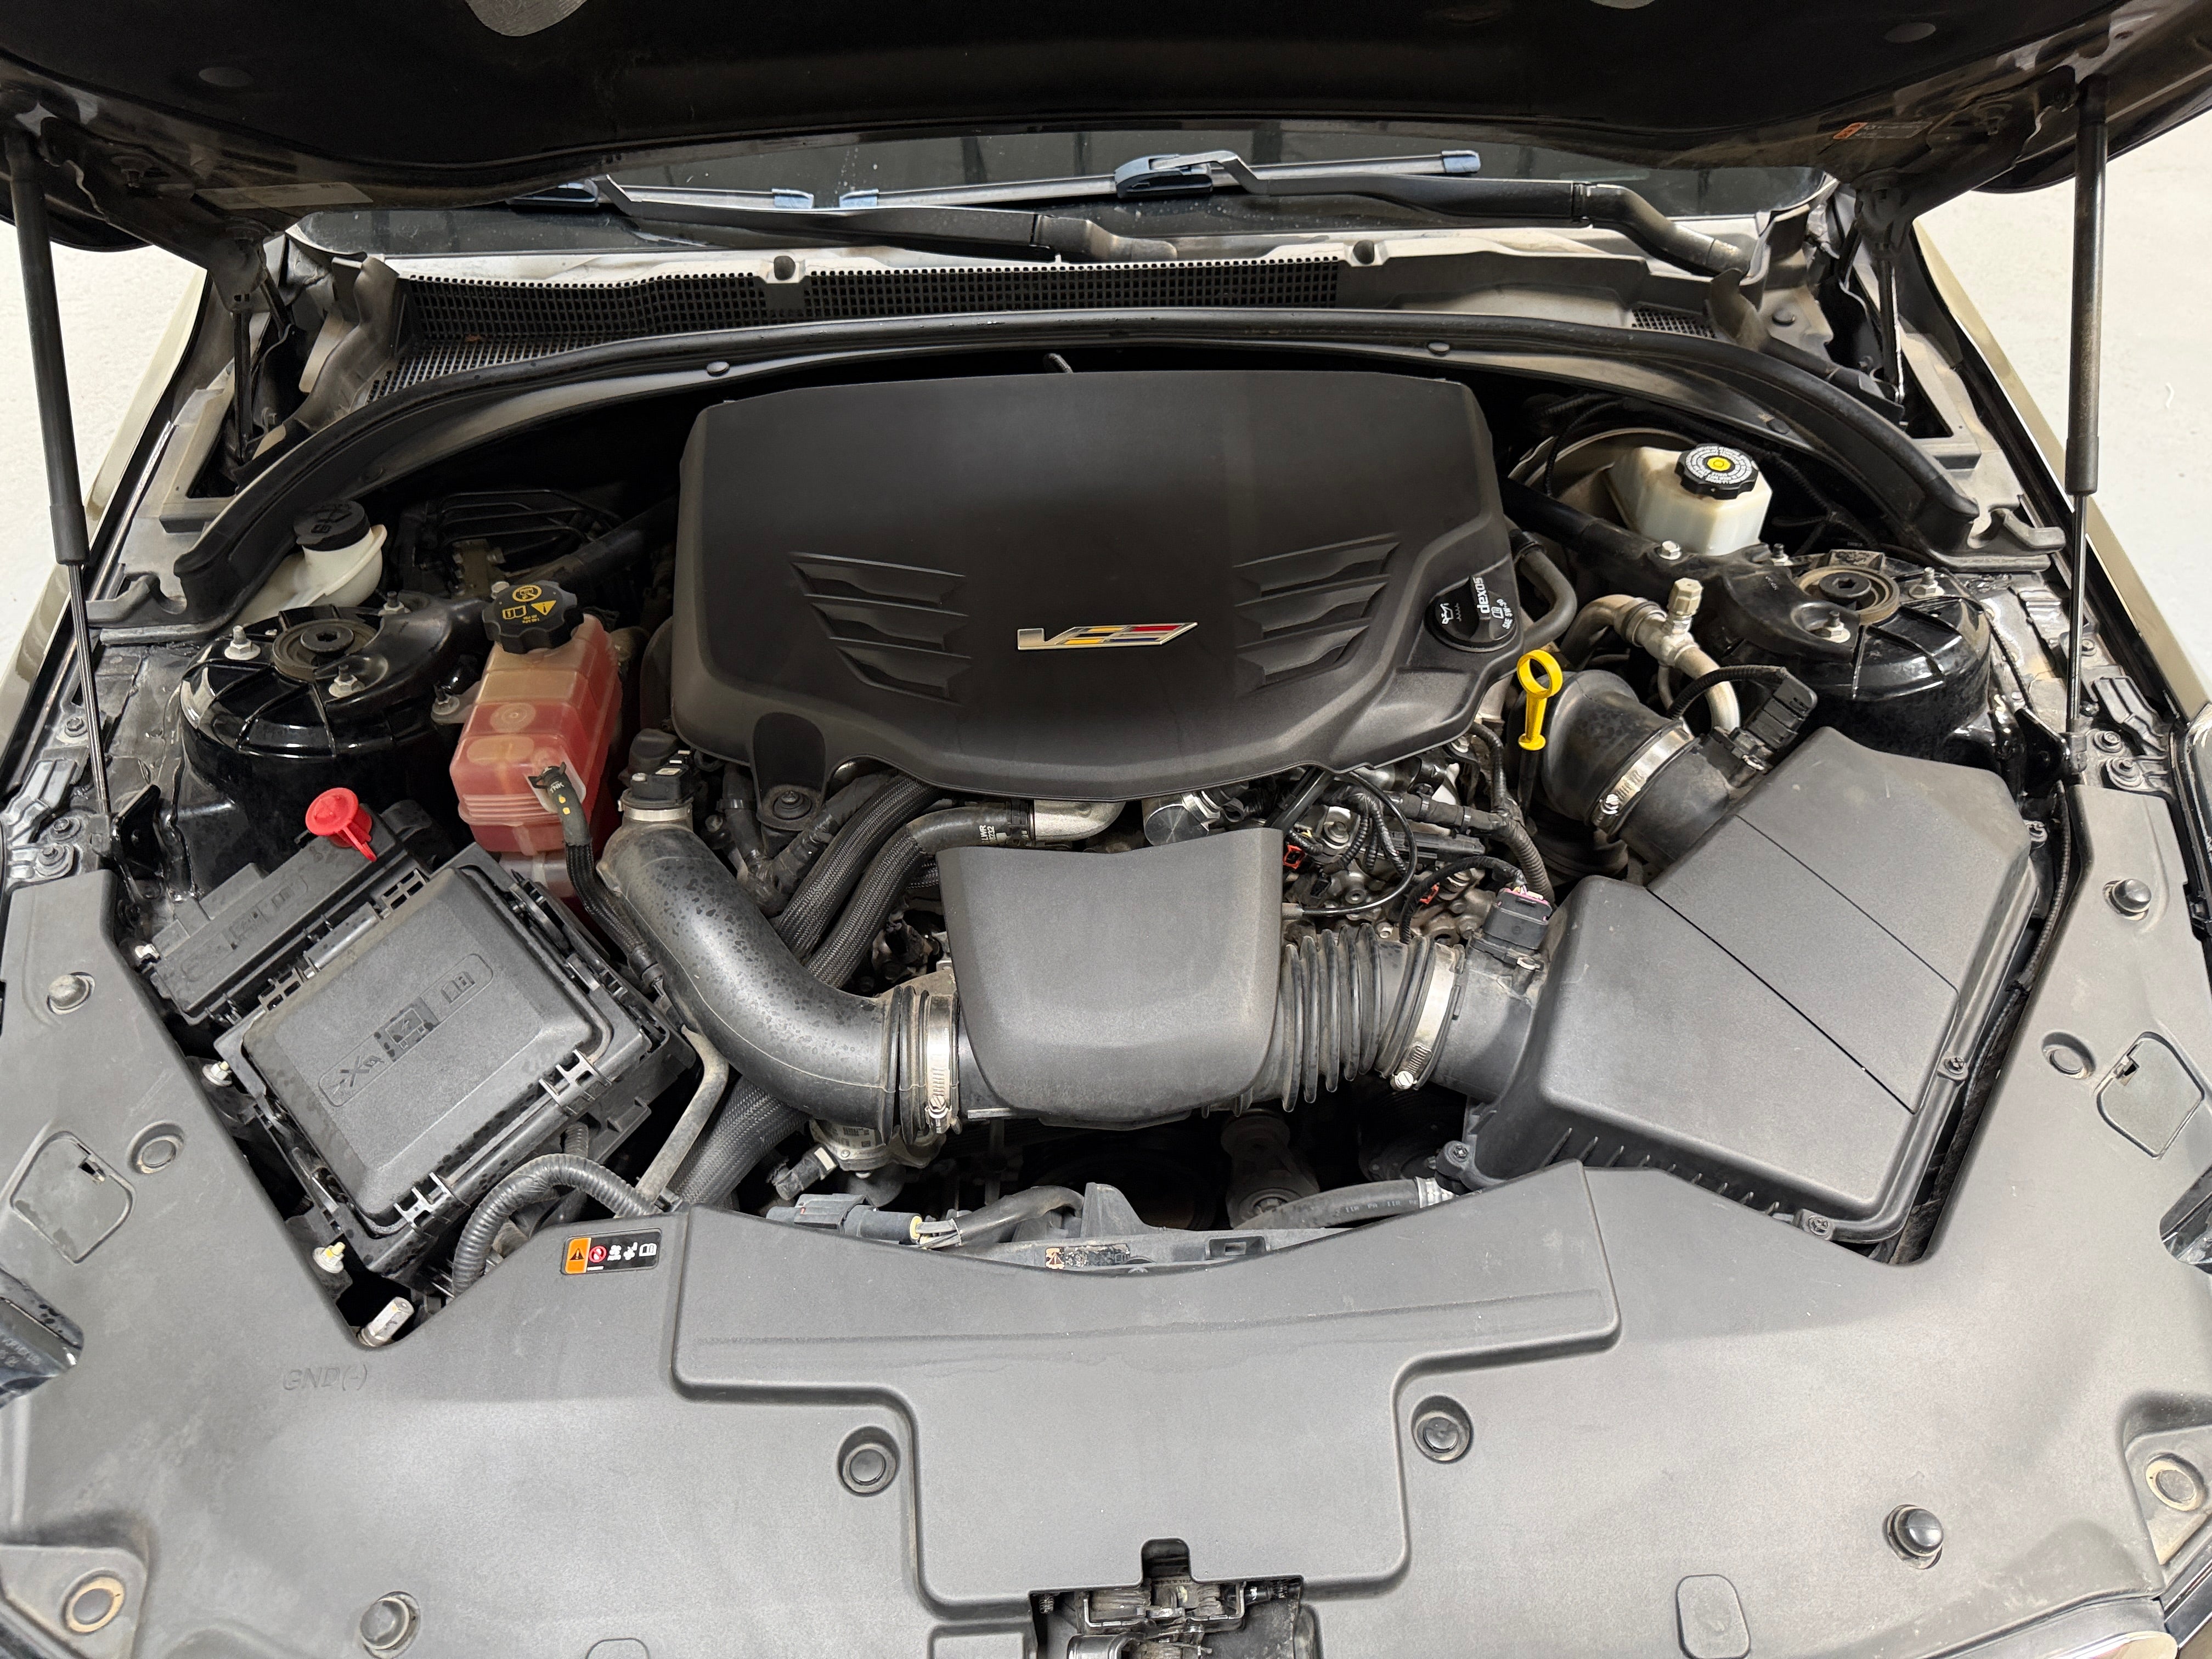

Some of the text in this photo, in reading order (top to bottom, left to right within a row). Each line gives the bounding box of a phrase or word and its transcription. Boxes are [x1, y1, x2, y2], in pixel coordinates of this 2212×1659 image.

[1472, 577, 1491, 614] dexos
[1496, 599, 1514, 629] SAE 5W-30
[283, 1364, 368, 1391] GND(-)
